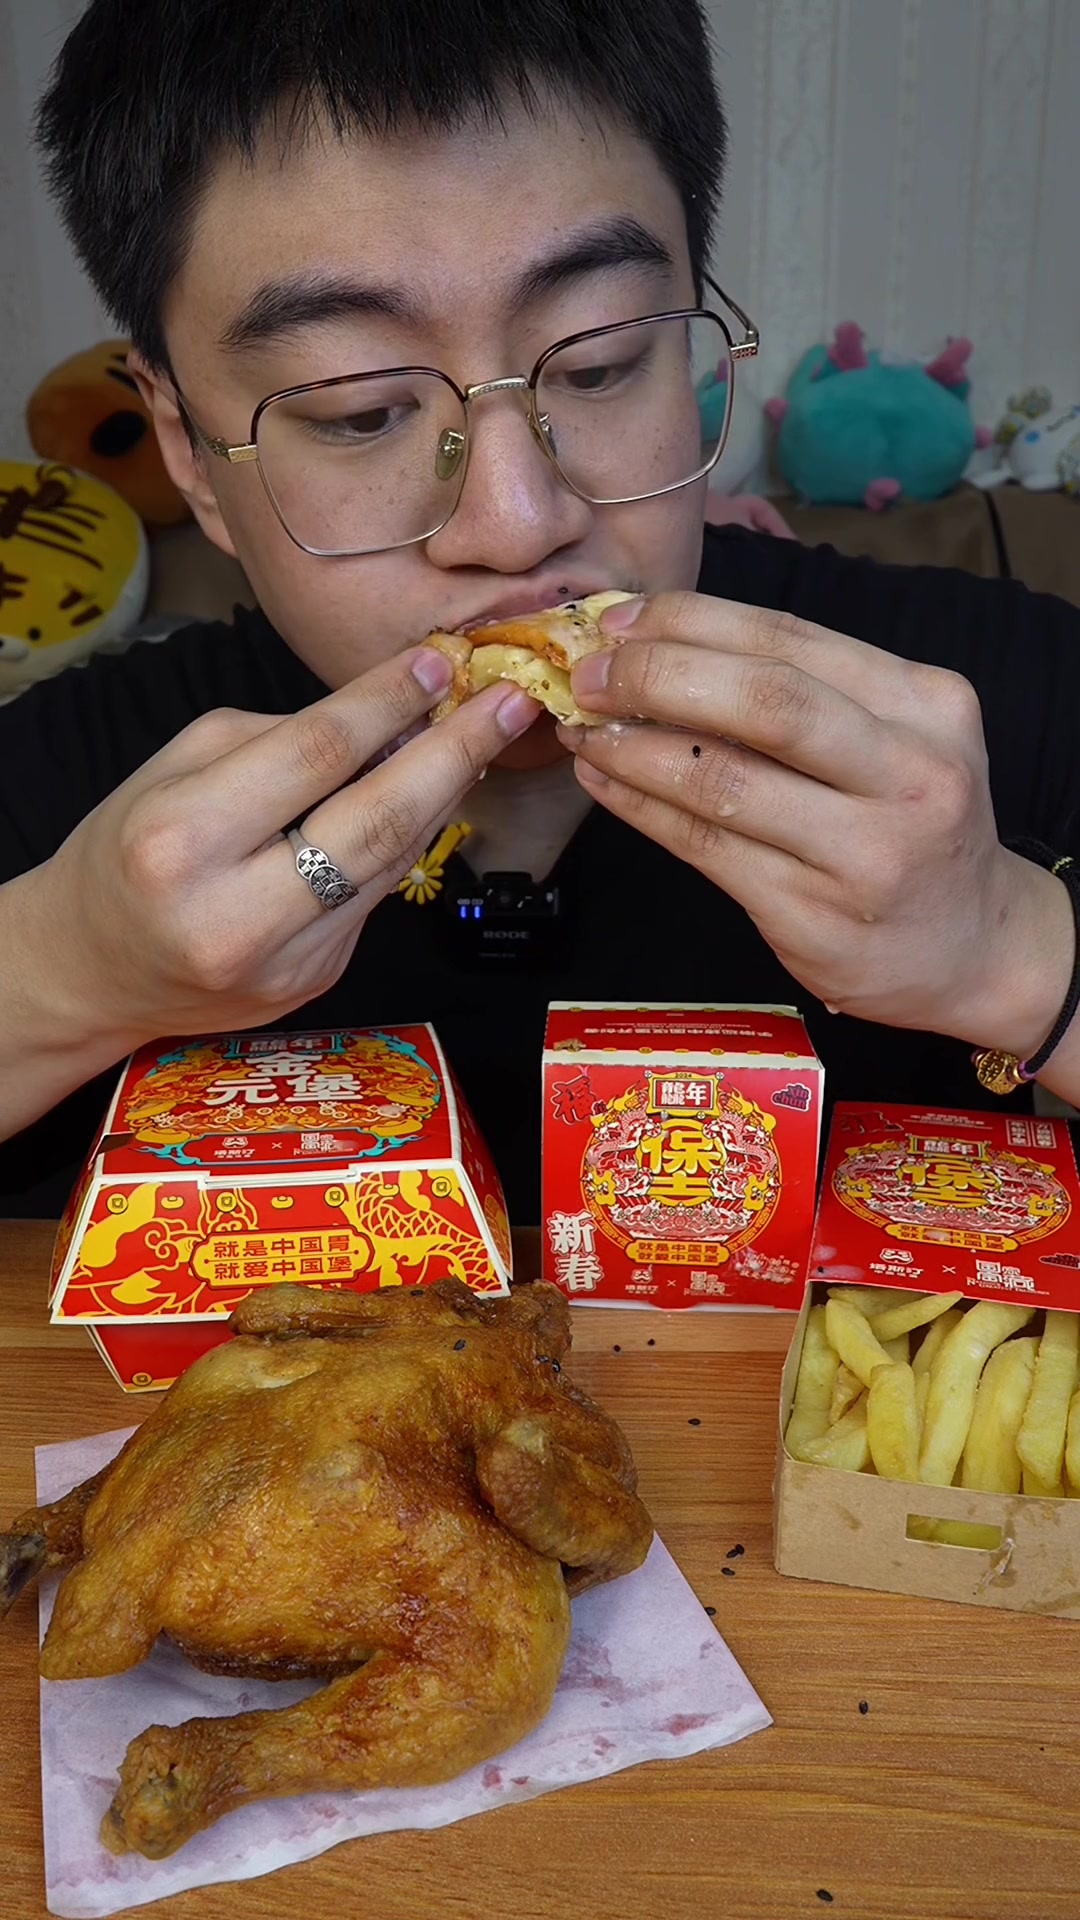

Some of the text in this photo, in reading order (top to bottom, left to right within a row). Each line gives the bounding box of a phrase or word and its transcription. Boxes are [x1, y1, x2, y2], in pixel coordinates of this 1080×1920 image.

[244, 1052, 322, 1076] 金
[204, 1074, 364, 1105] 元堡
[213, 1235, 350, 1258] 就是中国胃
[548, 1211, 602, 1291] 新春
[214, 1256, 352, 1279] 就爱中国堡
